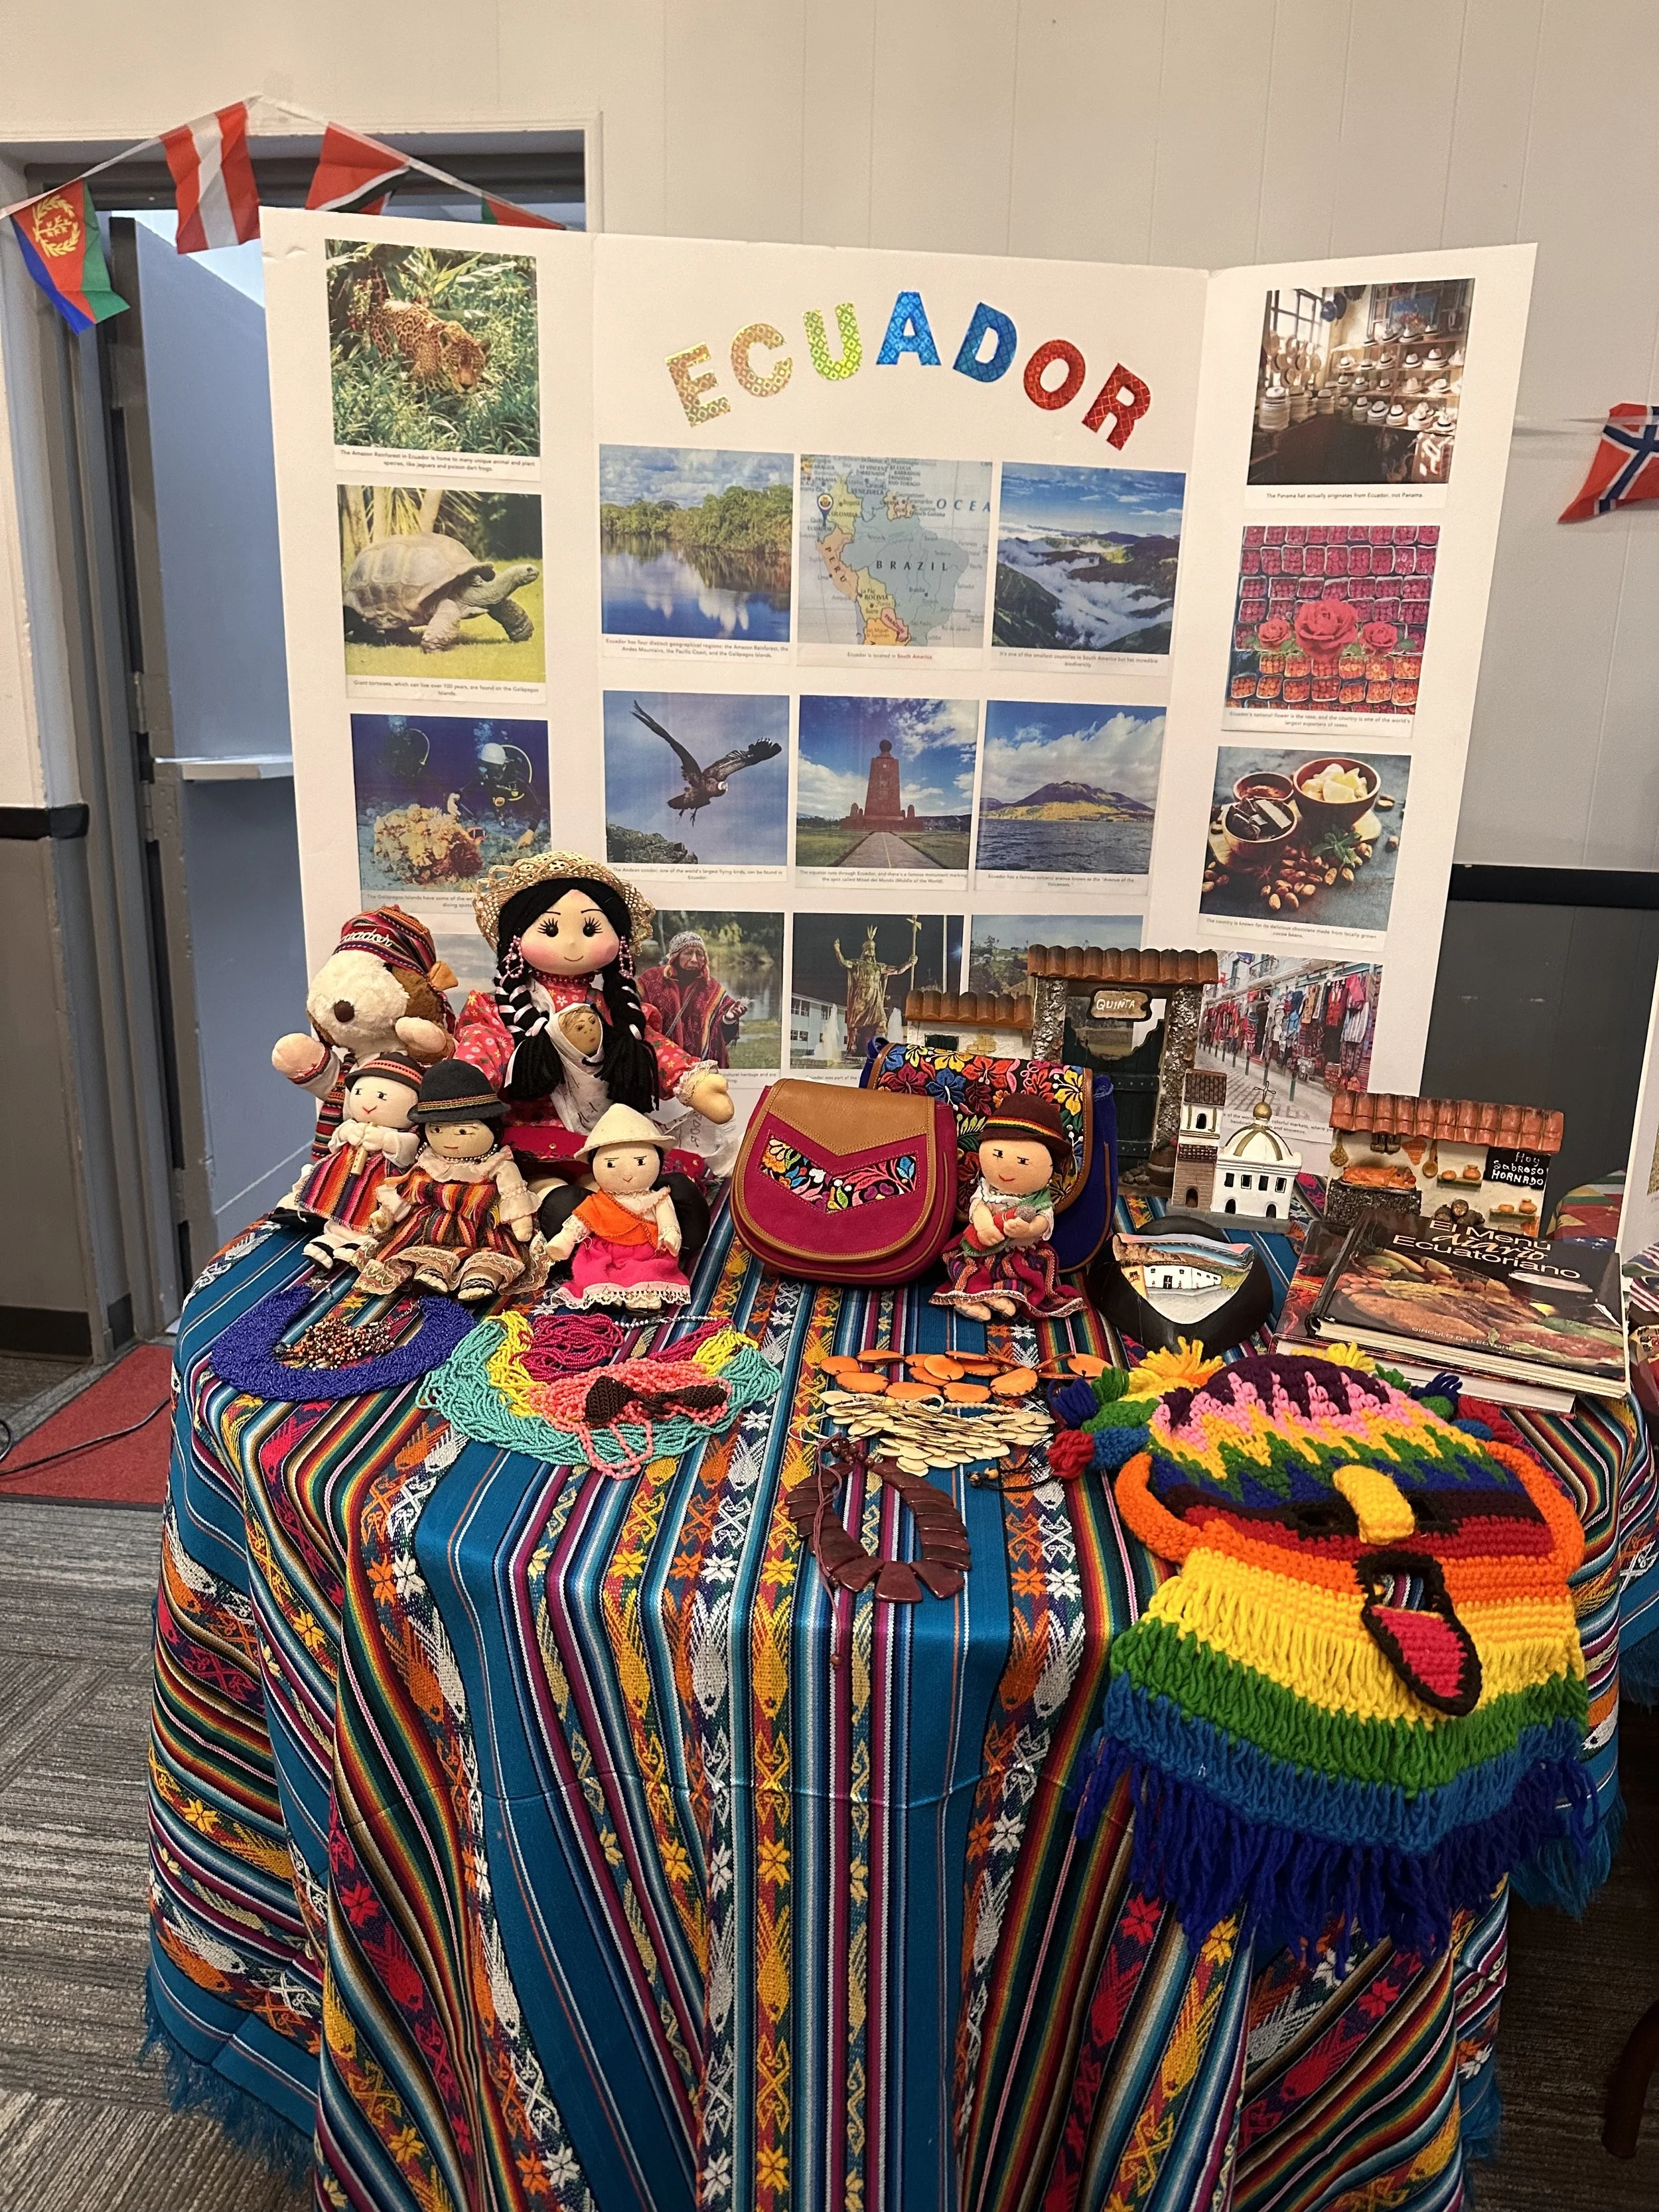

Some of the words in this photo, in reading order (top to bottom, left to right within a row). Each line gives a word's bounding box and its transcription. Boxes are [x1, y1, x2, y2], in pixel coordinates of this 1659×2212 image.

[665, 291, 1151, 451] ECUADOR
[825, 546, 847, 583] PERU
[877, 561, 948, 571] BRAZIL
[1096, 997, 1135, 1011] QUINTA
[1515, 1151, 1540, 1167] Hoy
[1491, 1169, 1544, 1185] HORNADO
[1429, 1219, 1457, 1232] El
[1466, 1226, 1551, 1251] Menú
[1431, 1233, 1548, 1260] diario
[1392, 1234, 1581, 1280] Ecuatoriano
